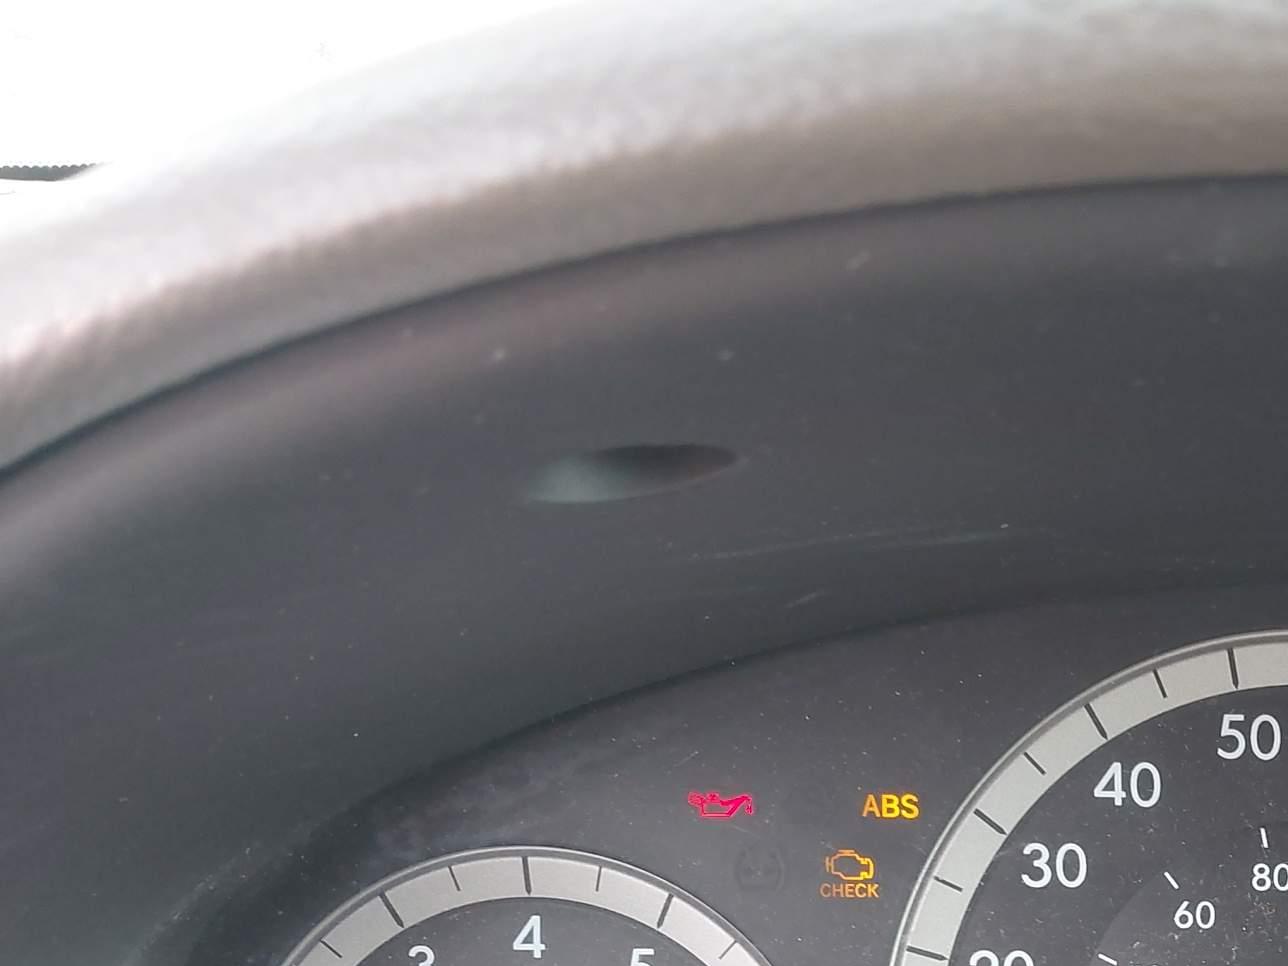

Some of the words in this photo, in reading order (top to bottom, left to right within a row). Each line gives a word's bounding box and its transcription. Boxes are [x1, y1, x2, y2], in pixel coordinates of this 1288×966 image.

[1217, 713, 1282, 762] 50
[862, 793, 919, 819] ABS
[1093, 762, 1161, 808] 40
[1020, 842, 1087, 888] 30
[820, 883, 879, 898] CHECK
[513, 915, 546, 959] 4
[1173, 901, 1216, 931] 60
